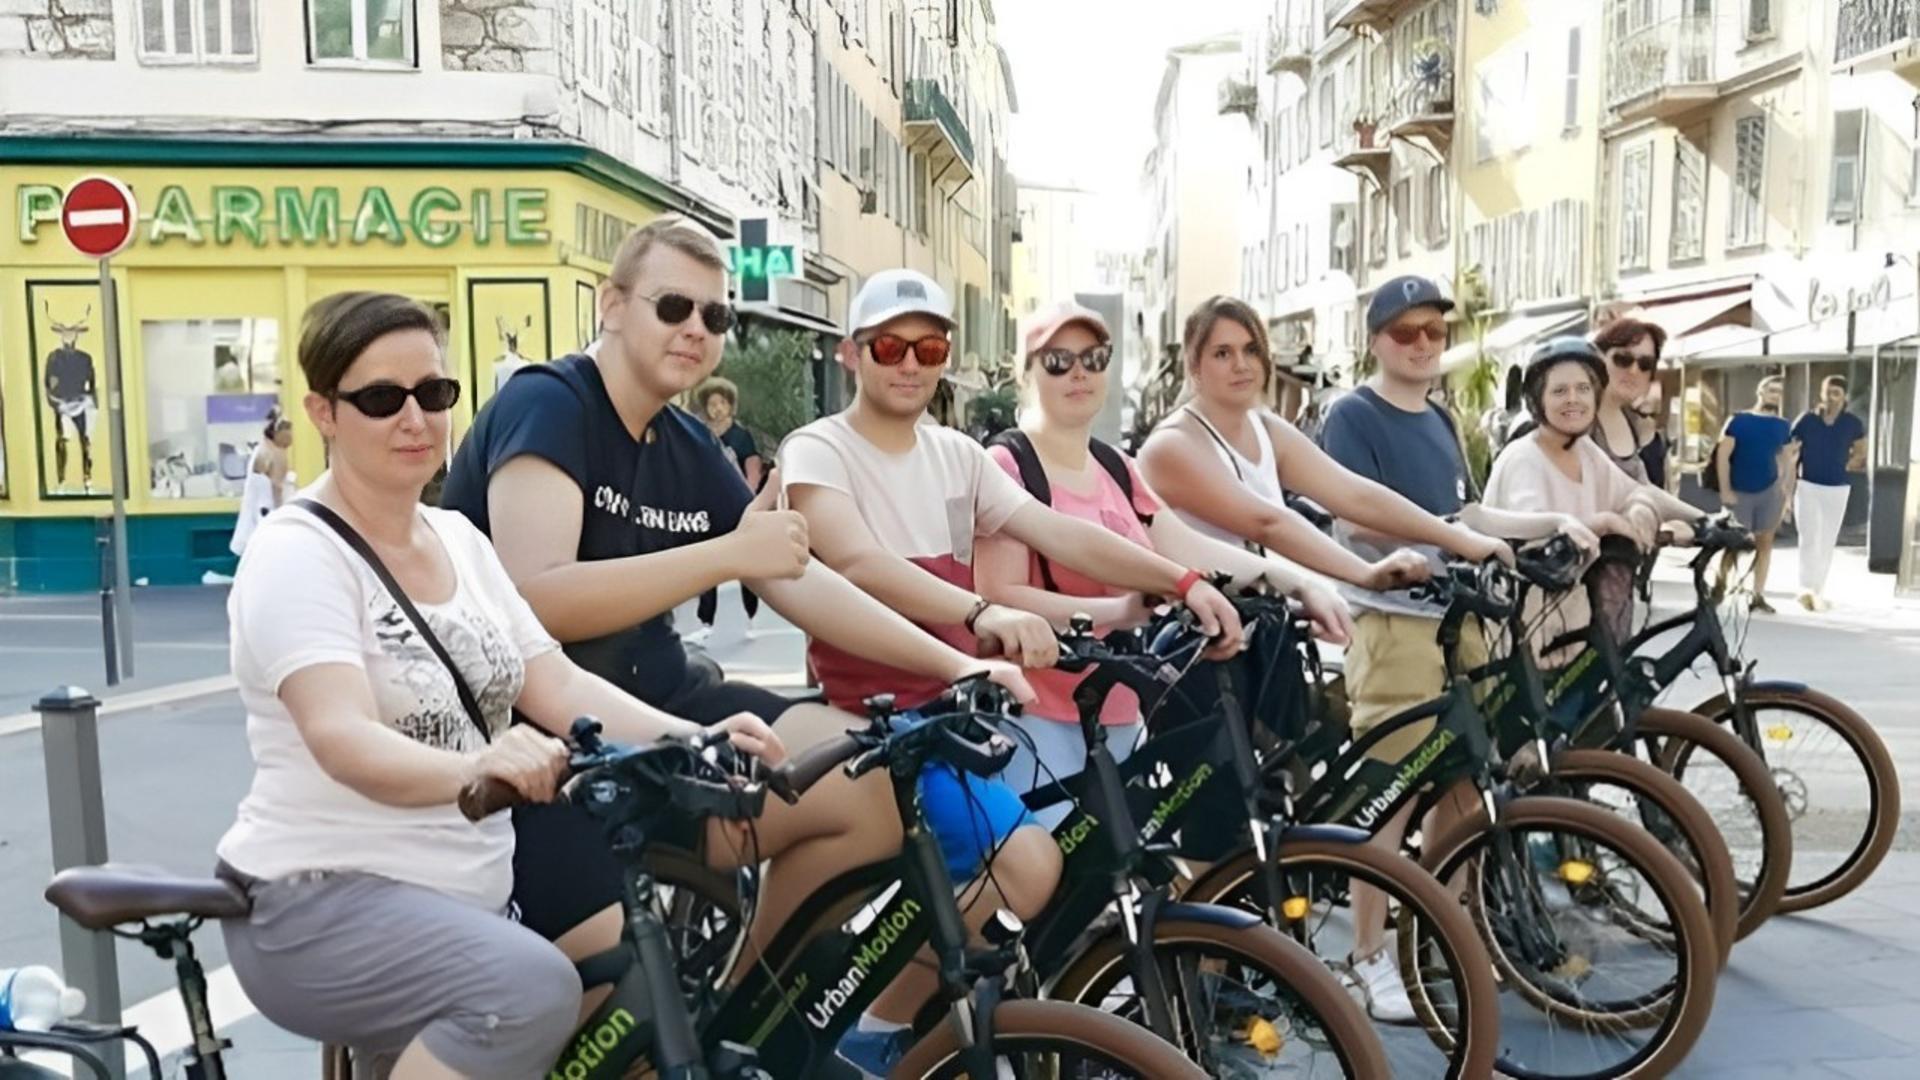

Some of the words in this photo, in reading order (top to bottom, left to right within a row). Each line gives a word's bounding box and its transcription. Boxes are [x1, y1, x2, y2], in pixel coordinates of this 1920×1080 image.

[18, 183, 552, 247] PARMACIE
[806, 898, 922, 1029] UrbanMotion
[550, 1007, 635, 1080] otion
